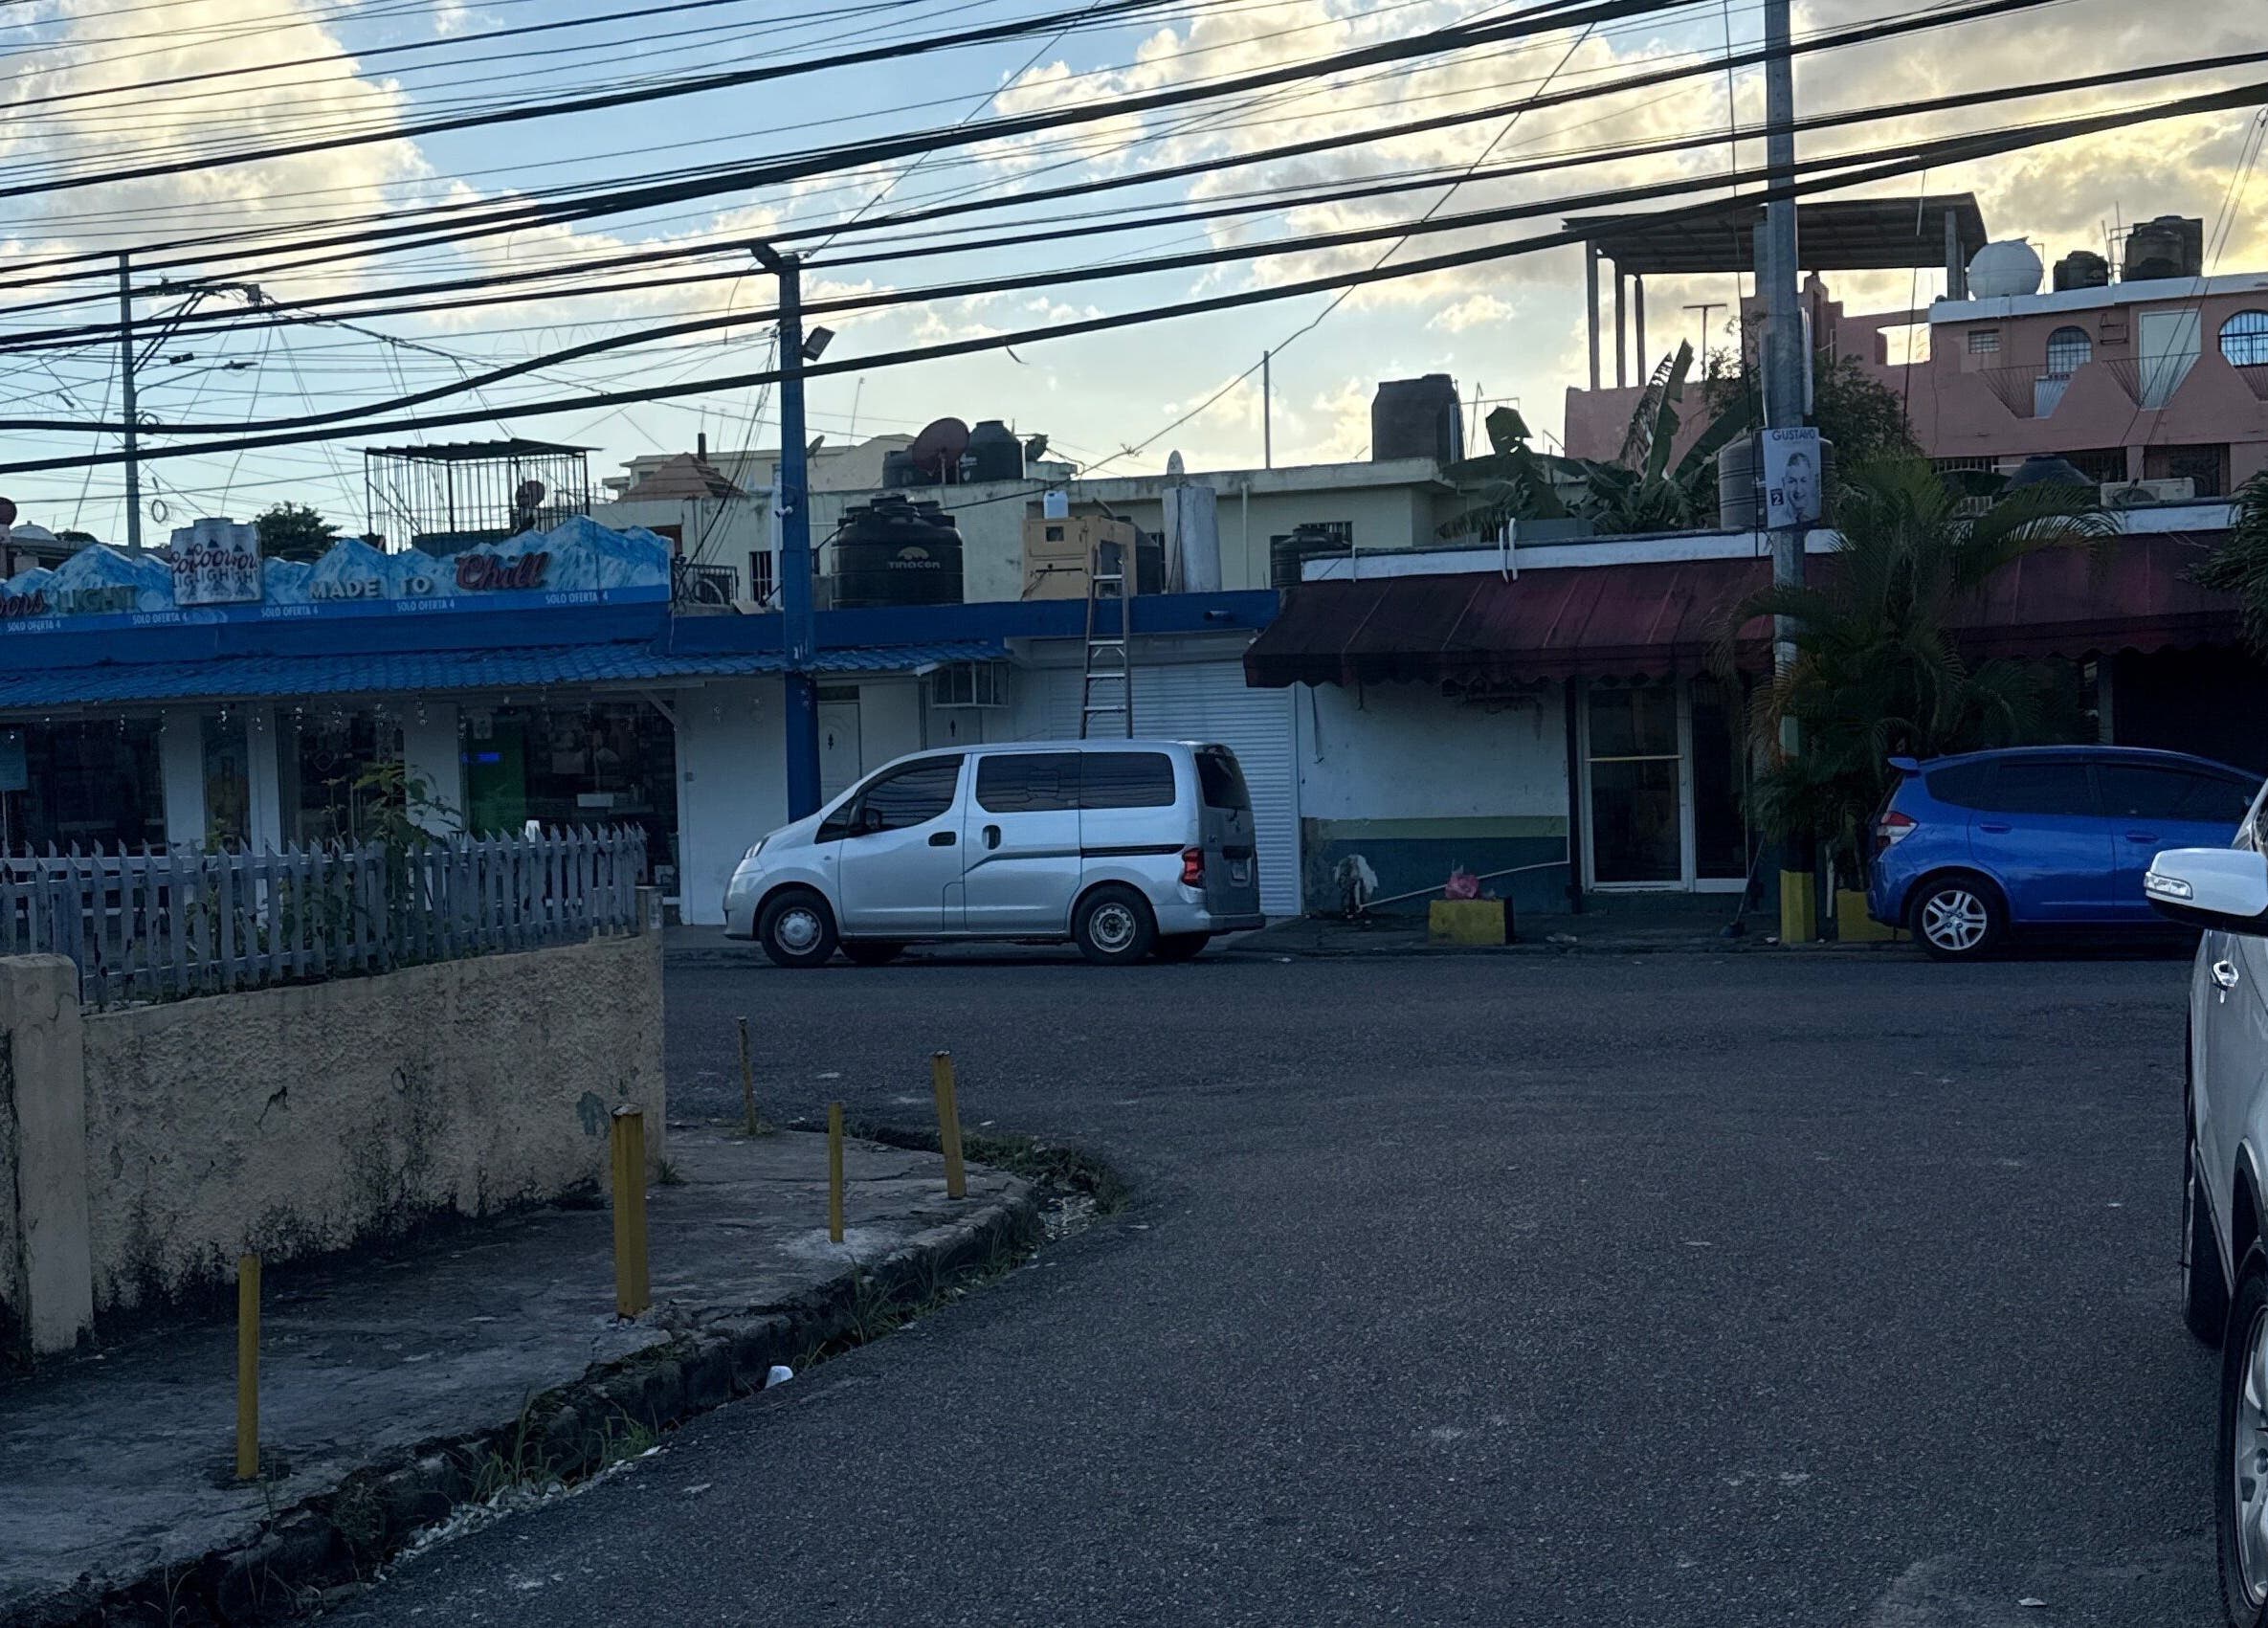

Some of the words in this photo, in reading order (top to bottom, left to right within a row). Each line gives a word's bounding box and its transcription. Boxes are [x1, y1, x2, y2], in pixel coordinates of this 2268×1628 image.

[1772, 429, 1815, 440] GUSTAVO
[1772, 494, 1782, 505] 2
[310, 580, 379, 599] MADE
[401, 575, 434, 595] TO
[455, 551, 550, 591] Chill
[59, 585, 138, 613] LIGHT
[568, 592, 598, 604] OFERTA
[282, 605, 311, 617] OFERTA
[418, 599, 448, 612] OFERTA
[152, 611, 180, 624] OFERTA
[27, 619, 55, 632] OFERTA
